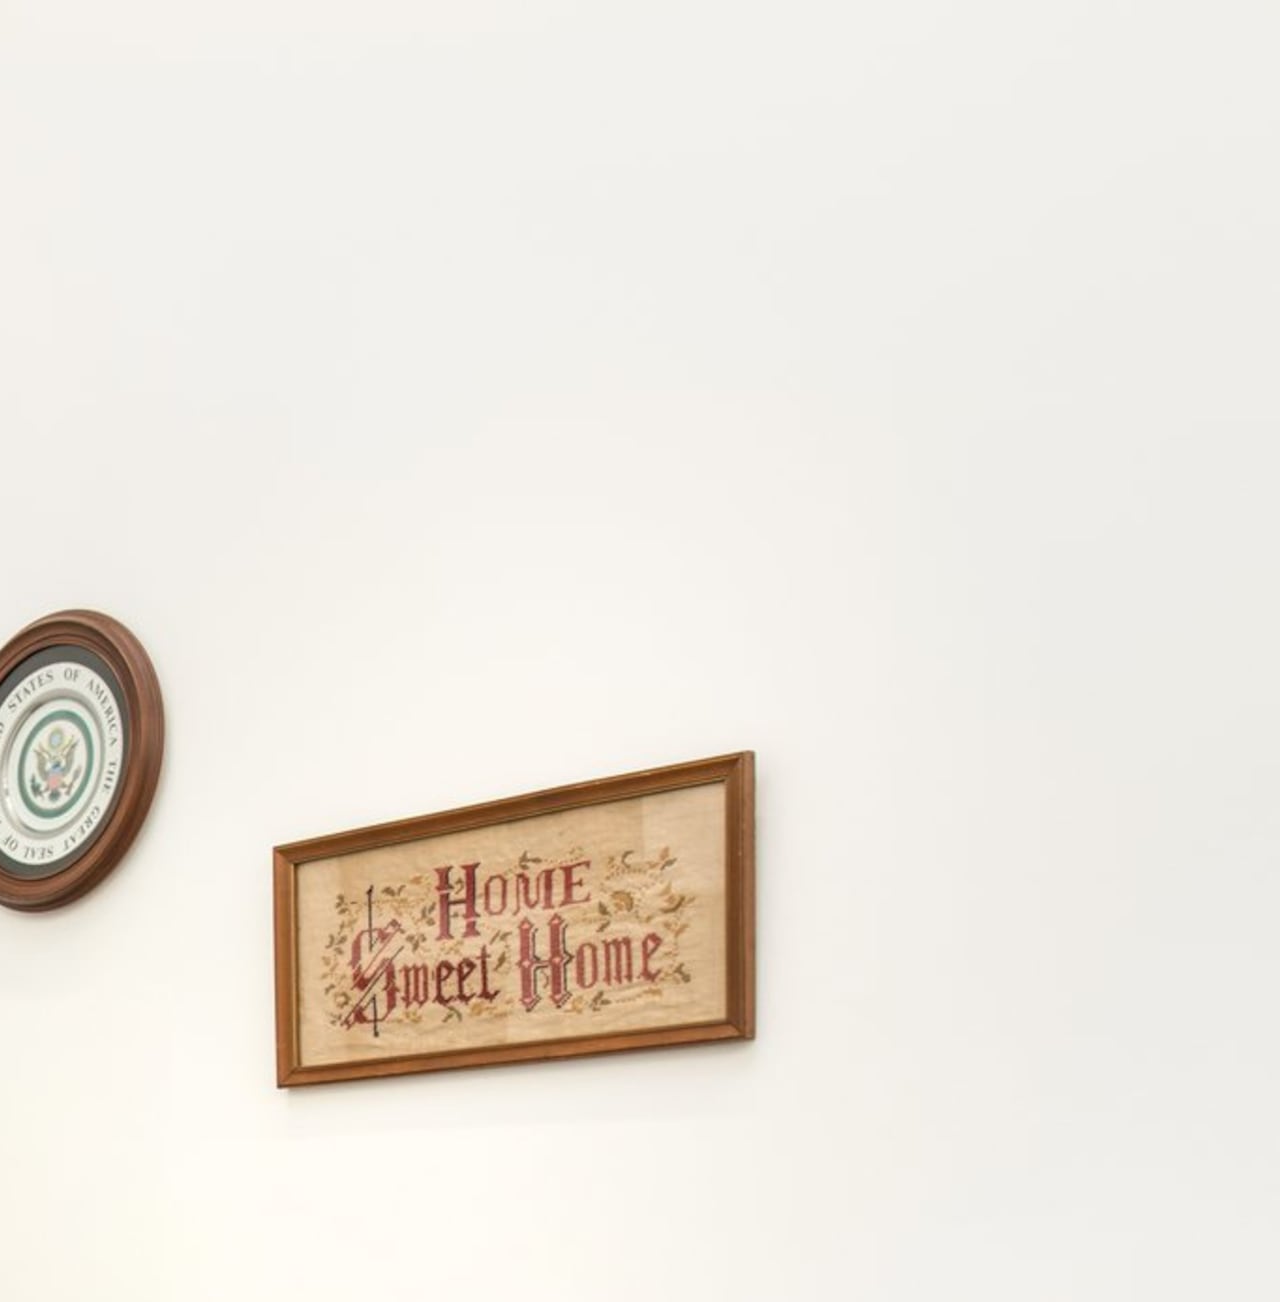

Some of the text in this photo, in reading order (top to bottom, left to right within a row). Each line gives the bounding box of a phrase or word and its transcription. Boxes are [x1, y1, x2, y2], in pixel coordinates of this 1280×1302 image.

[7, 670, 54, 711] STATES
[63, 668, 80, 683] OF
[87, 678, 118, 747] AMERICA
[434, 860, 592, 941] HOME
[341, 901, 663, 1034] Sweet Home
